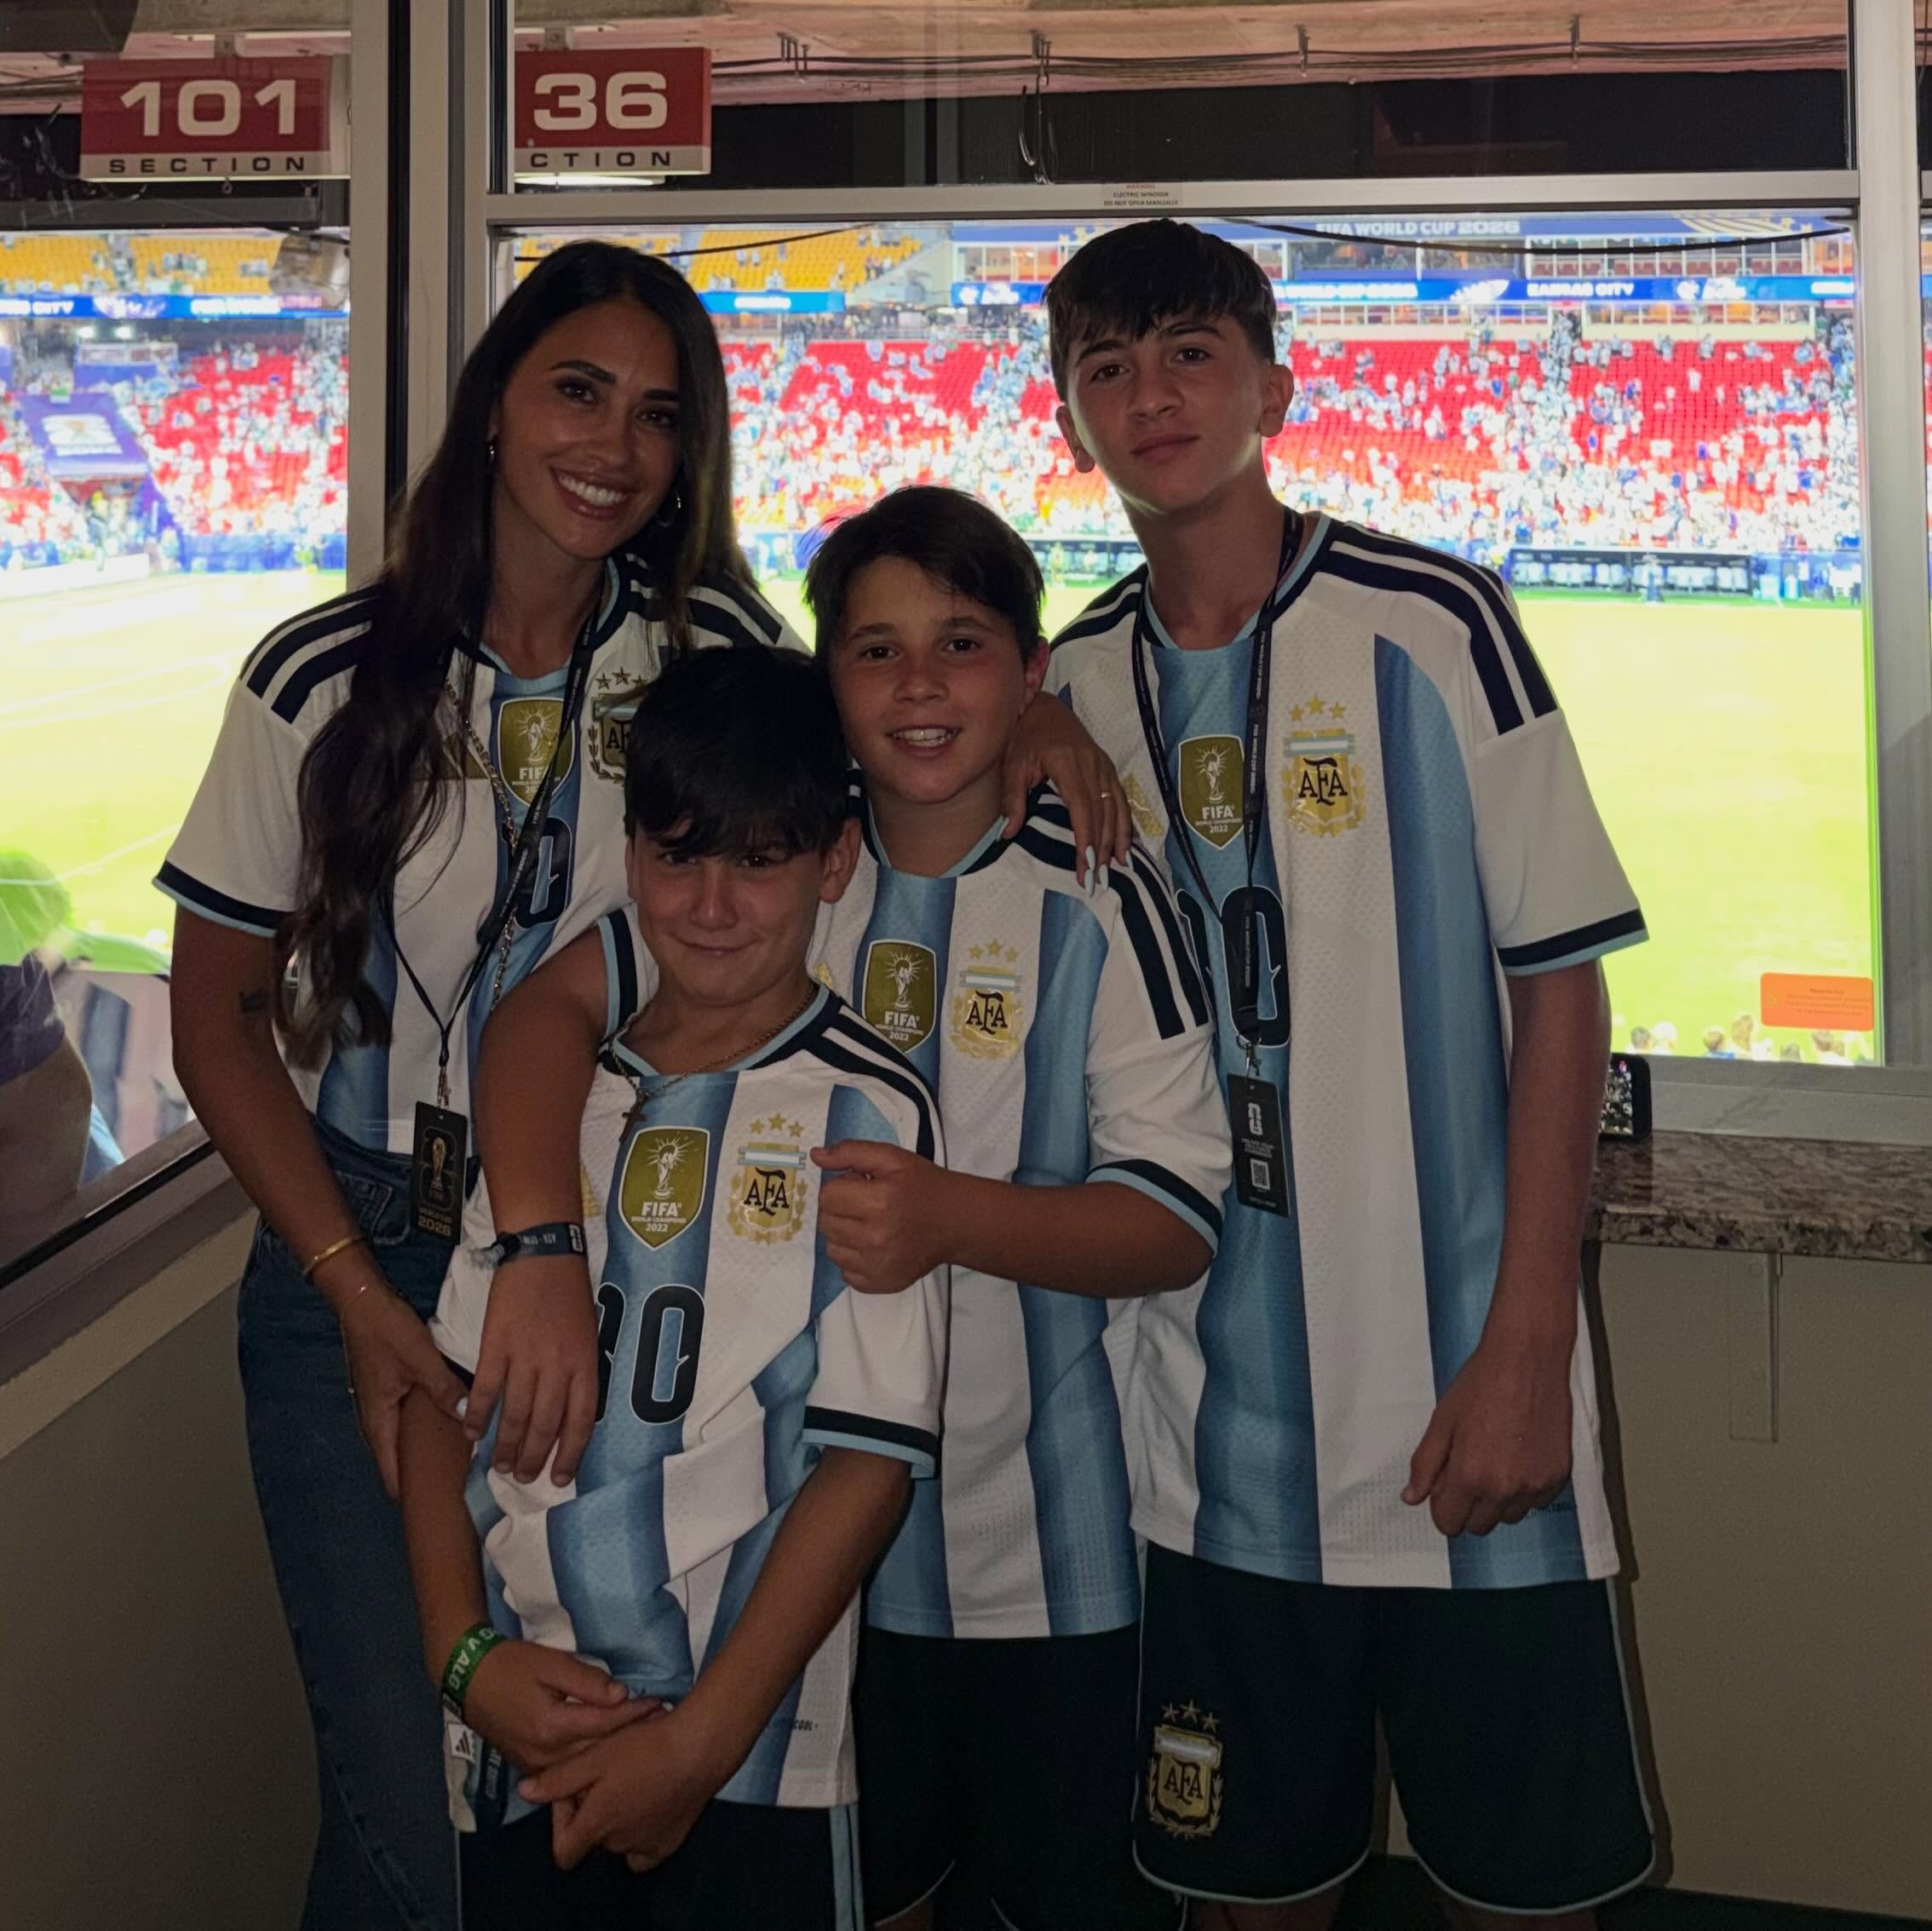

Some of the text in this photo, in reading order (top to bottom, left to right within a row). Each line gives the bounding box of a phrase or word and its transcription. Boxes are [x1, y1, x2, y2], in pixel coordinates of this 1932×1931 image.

[120, 79, 296, 136] 101
[534, 71, 668, 130] 36
[110, 157, 304, 173] SECTION
[531, 152, 670, 167] CTION
[1316, 221, 1521, 236] FIFA WORLD CUP 2026
[519, 767, 549, 780] FIF
[1298, 757, 1348, 807] AFA
[1202, 804, 1234, 819] FIFA
[1210, 825, 1228, 834] 2022
[884, 1011, 917, 1029] FIFA
[965, 989, 1008, 1035] AFA
[888, 1031, 910, 1042] 2022
[744, 1167, 790, 1215] AFA
[641, 1201, 679, 1217] FIFA
[645, 1222, 669, 1233] 2022
[1164, 1756, 1204, 1805] AFA
